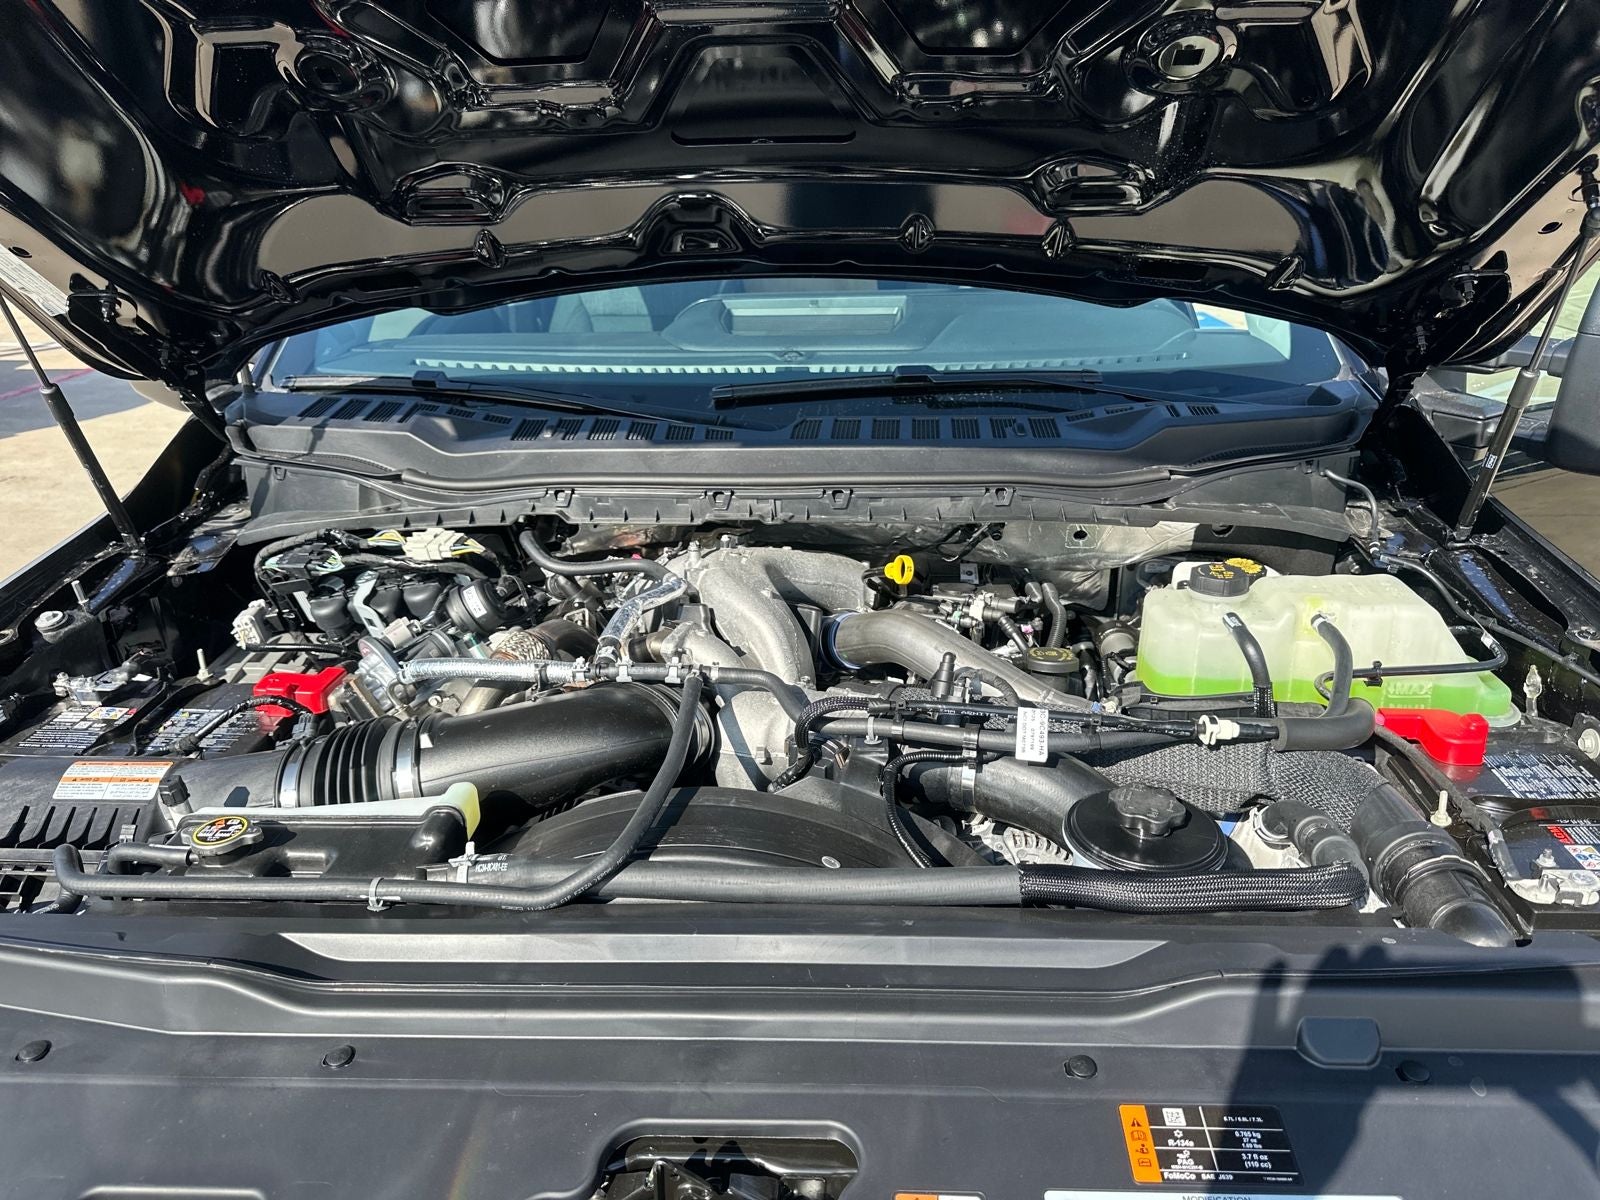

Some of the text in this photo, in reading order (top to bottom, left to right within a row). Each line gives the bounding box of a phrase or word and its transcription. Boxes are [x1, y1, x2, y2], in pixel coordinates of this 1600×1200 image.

[1252, 1131, 1262, 1139] kg
[1167, 1139, 1195, 1147] R-134a
[1177, 1158, 1195, 1166] PAG
[1244, 1160, 1273, 1170] (110 cc)
[1163, 1171, 1197, 1180] FoMoCo
